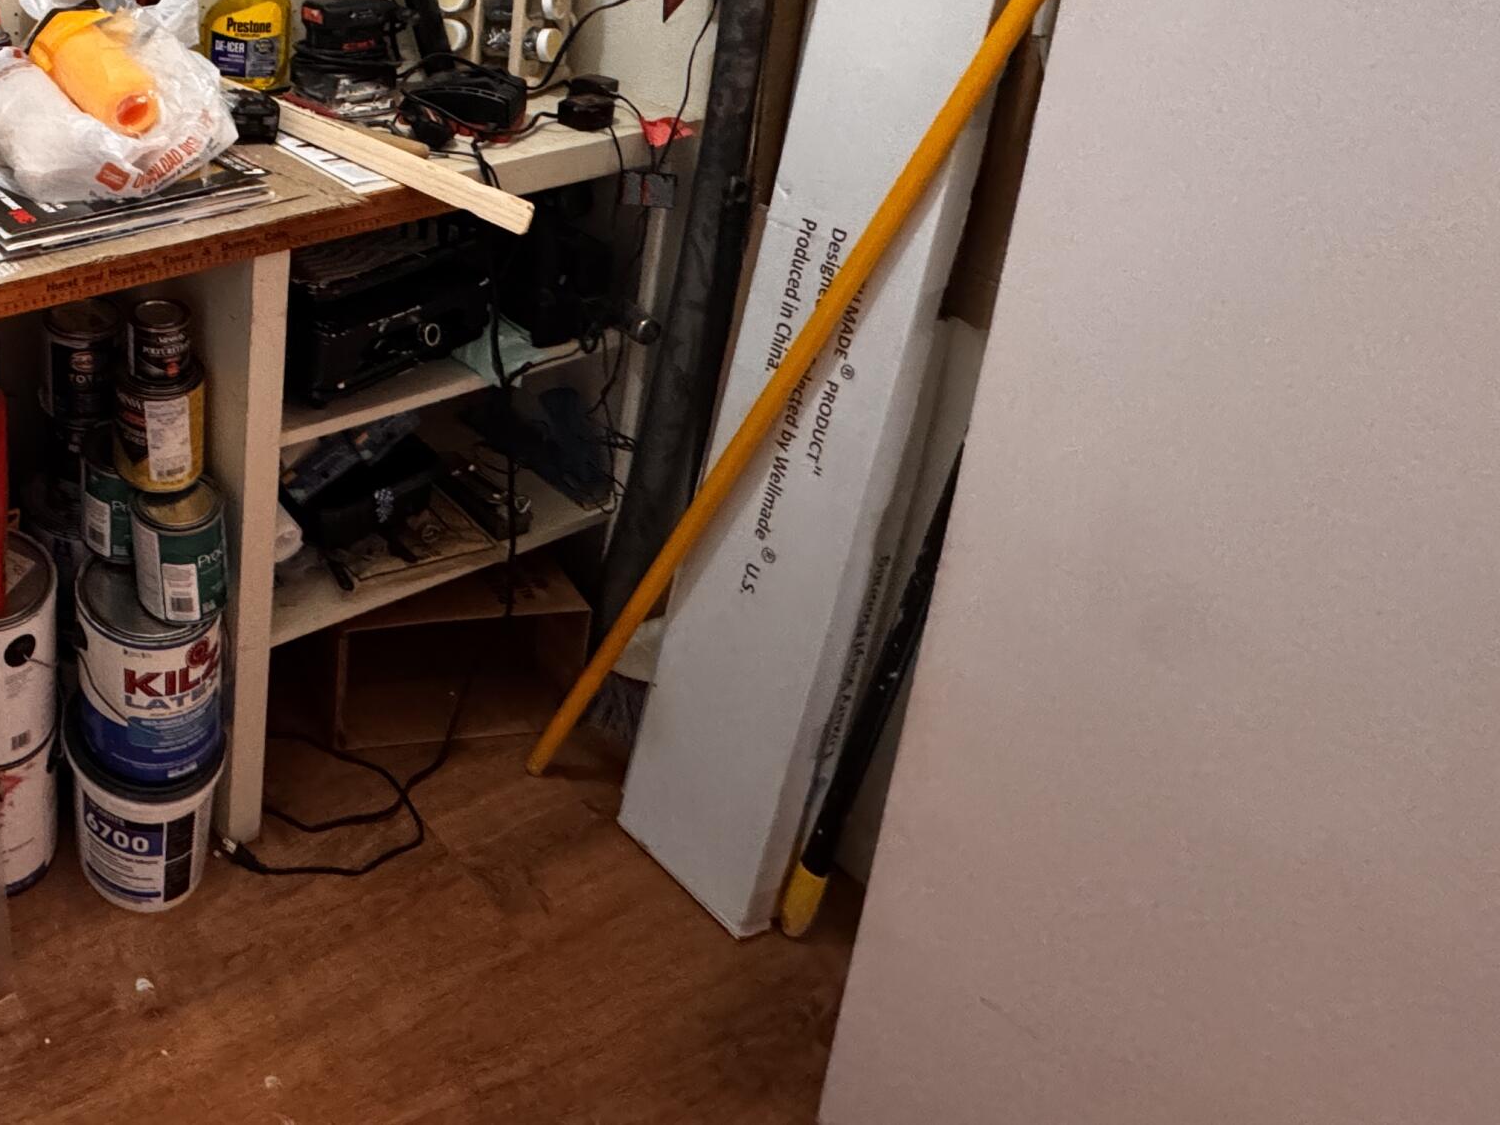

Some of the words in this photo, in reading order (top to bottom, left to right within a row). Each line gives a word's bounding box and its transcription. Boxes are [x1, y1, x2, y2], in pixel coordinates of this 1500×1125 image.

[226, 17, 272, 34] Prestone
[214, 39, 245, 53] DE-ICER
[784, 217, 818, 304] Produced
[814, 227, 848, 306] Designe
[779, 301, 800, 320] in
[764, 322, 793, 372] China.
[774, 430, 798, 454] by
[754, 454, 790, 542] Wellmade
[739, 561, 762, 596] U.S.
[85, 811, 150, 854] 6700
